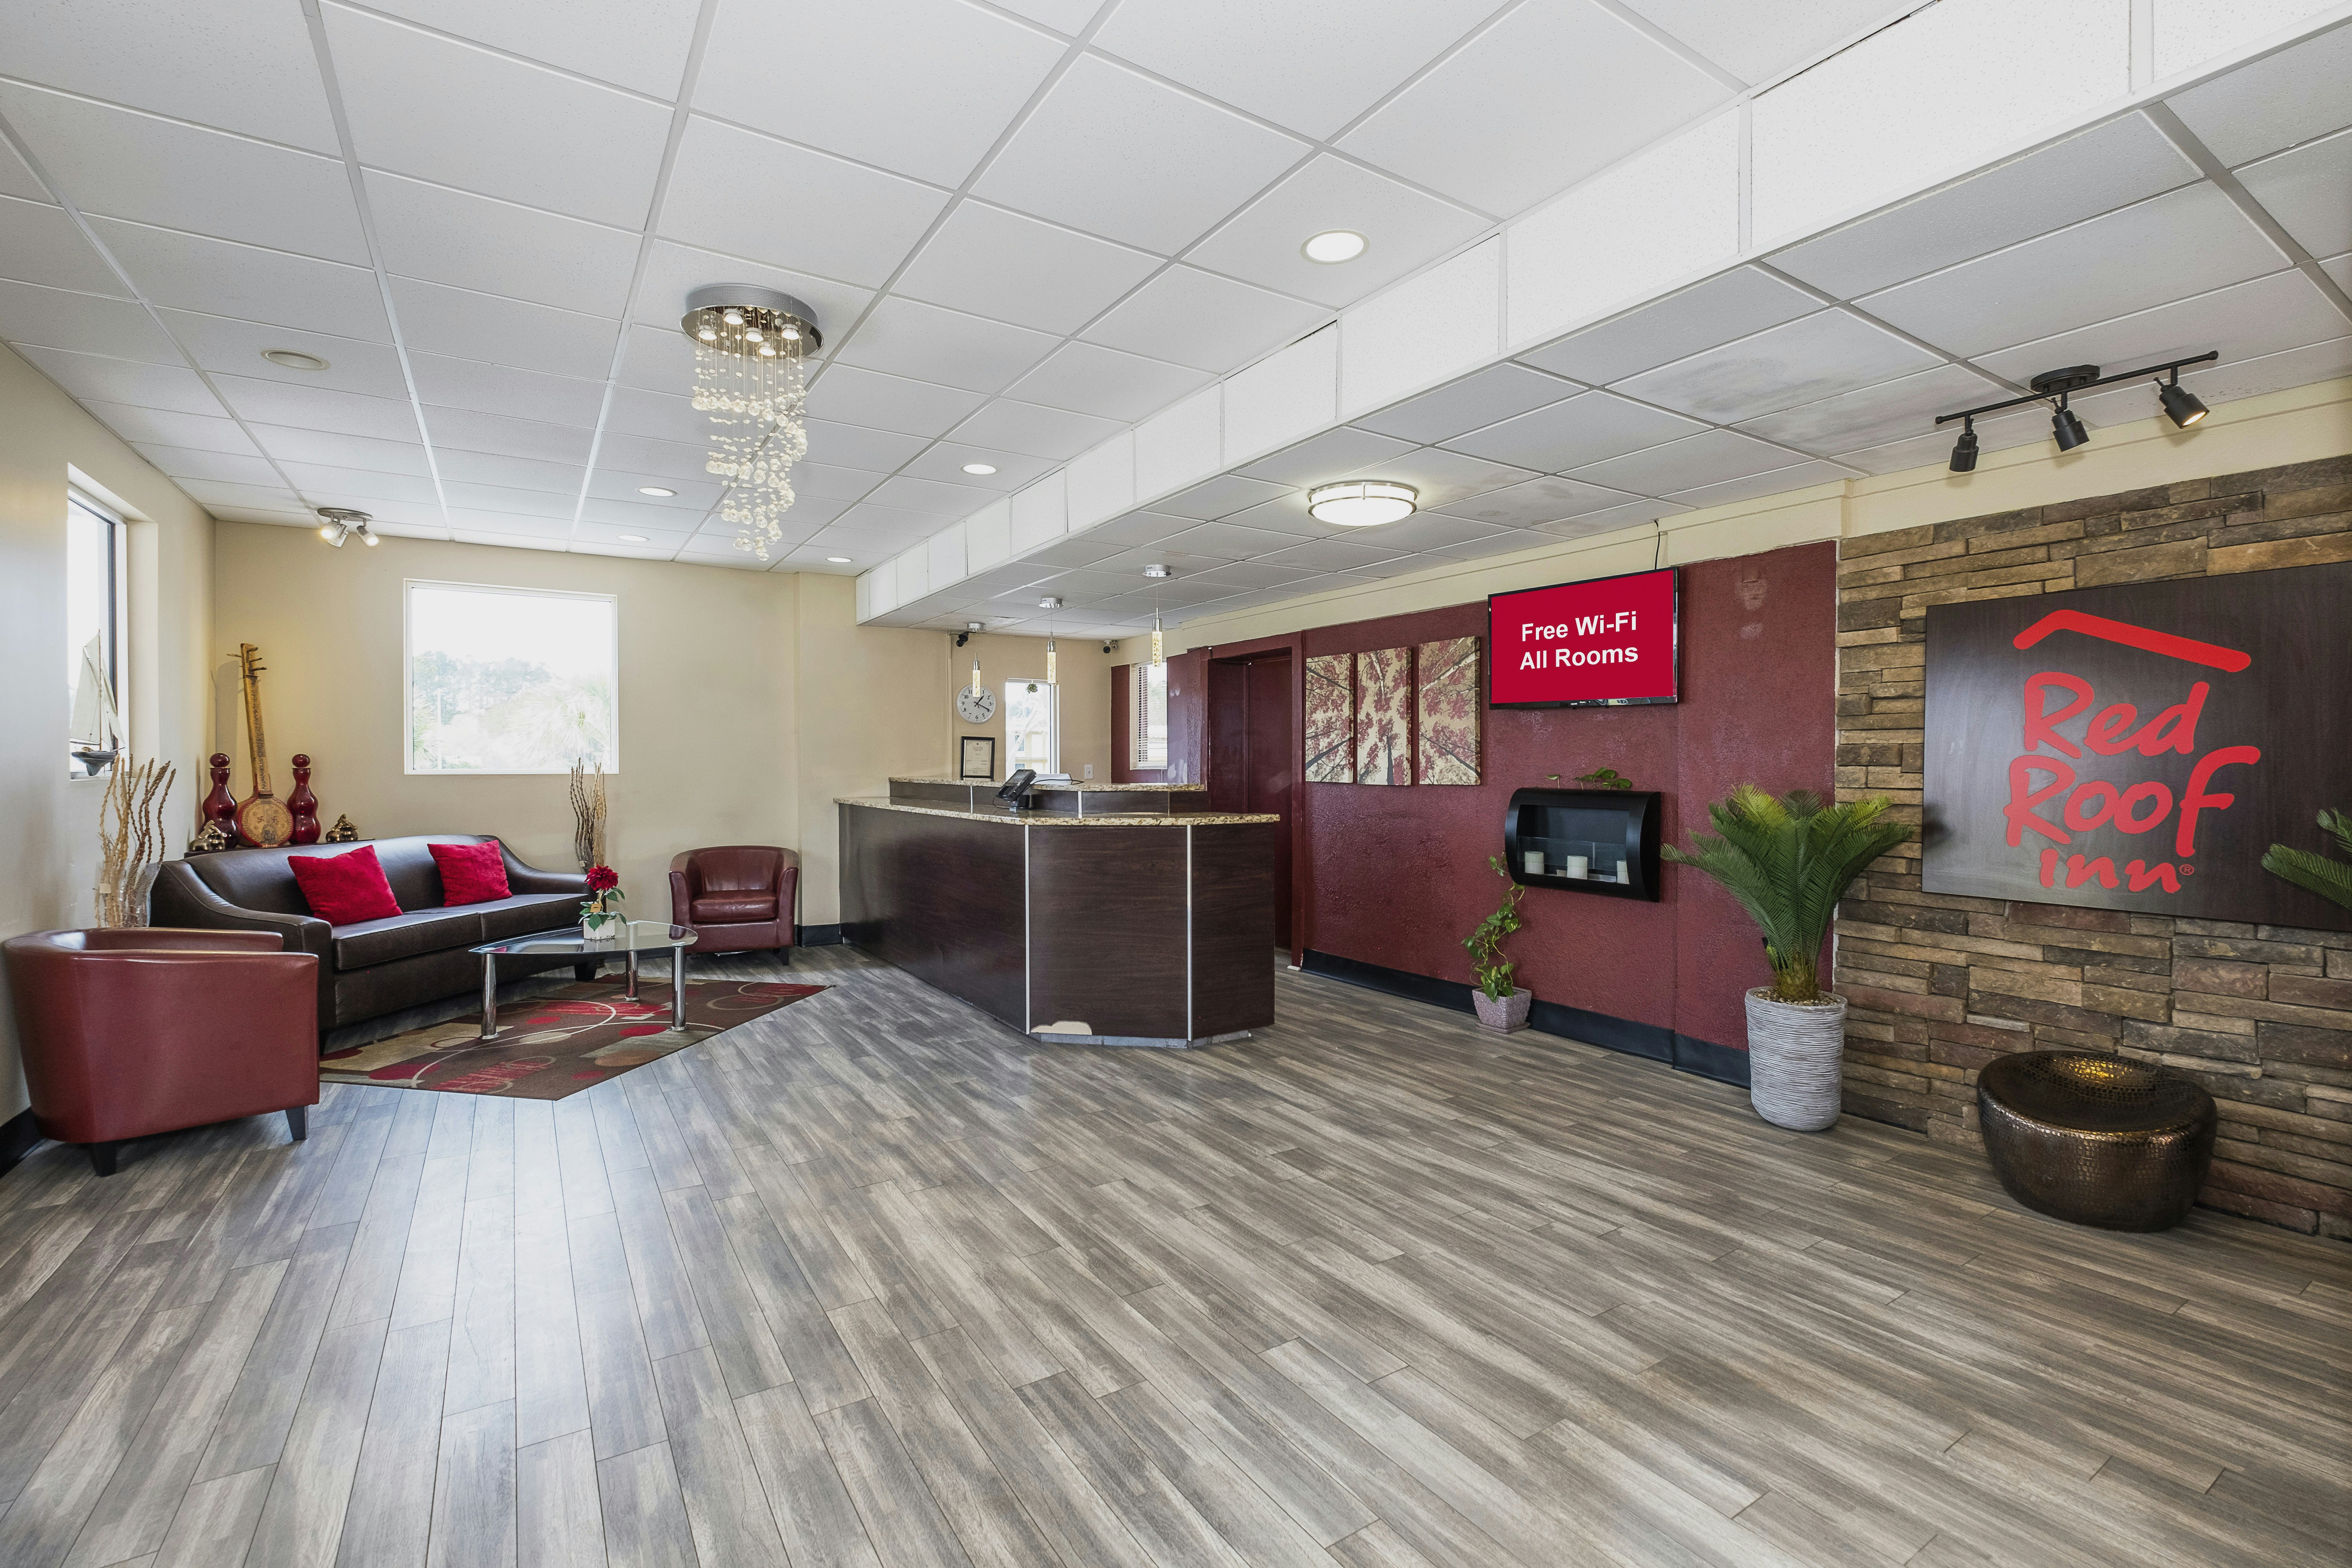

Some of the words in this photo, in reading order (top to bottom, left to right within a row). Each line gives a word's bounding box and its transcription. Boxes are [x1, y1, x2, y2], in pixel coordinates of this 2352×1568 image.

[1522, 623, 1568, 642] Free
[1575, 611, 1637, 636] Wi-Fi
[1519, 650, 1547, 670] All
[1555, 646, 1639, 667] Rooms
[2024, 671, 2210, 759] Red
[2003, 746, 2261, 858] Roof
